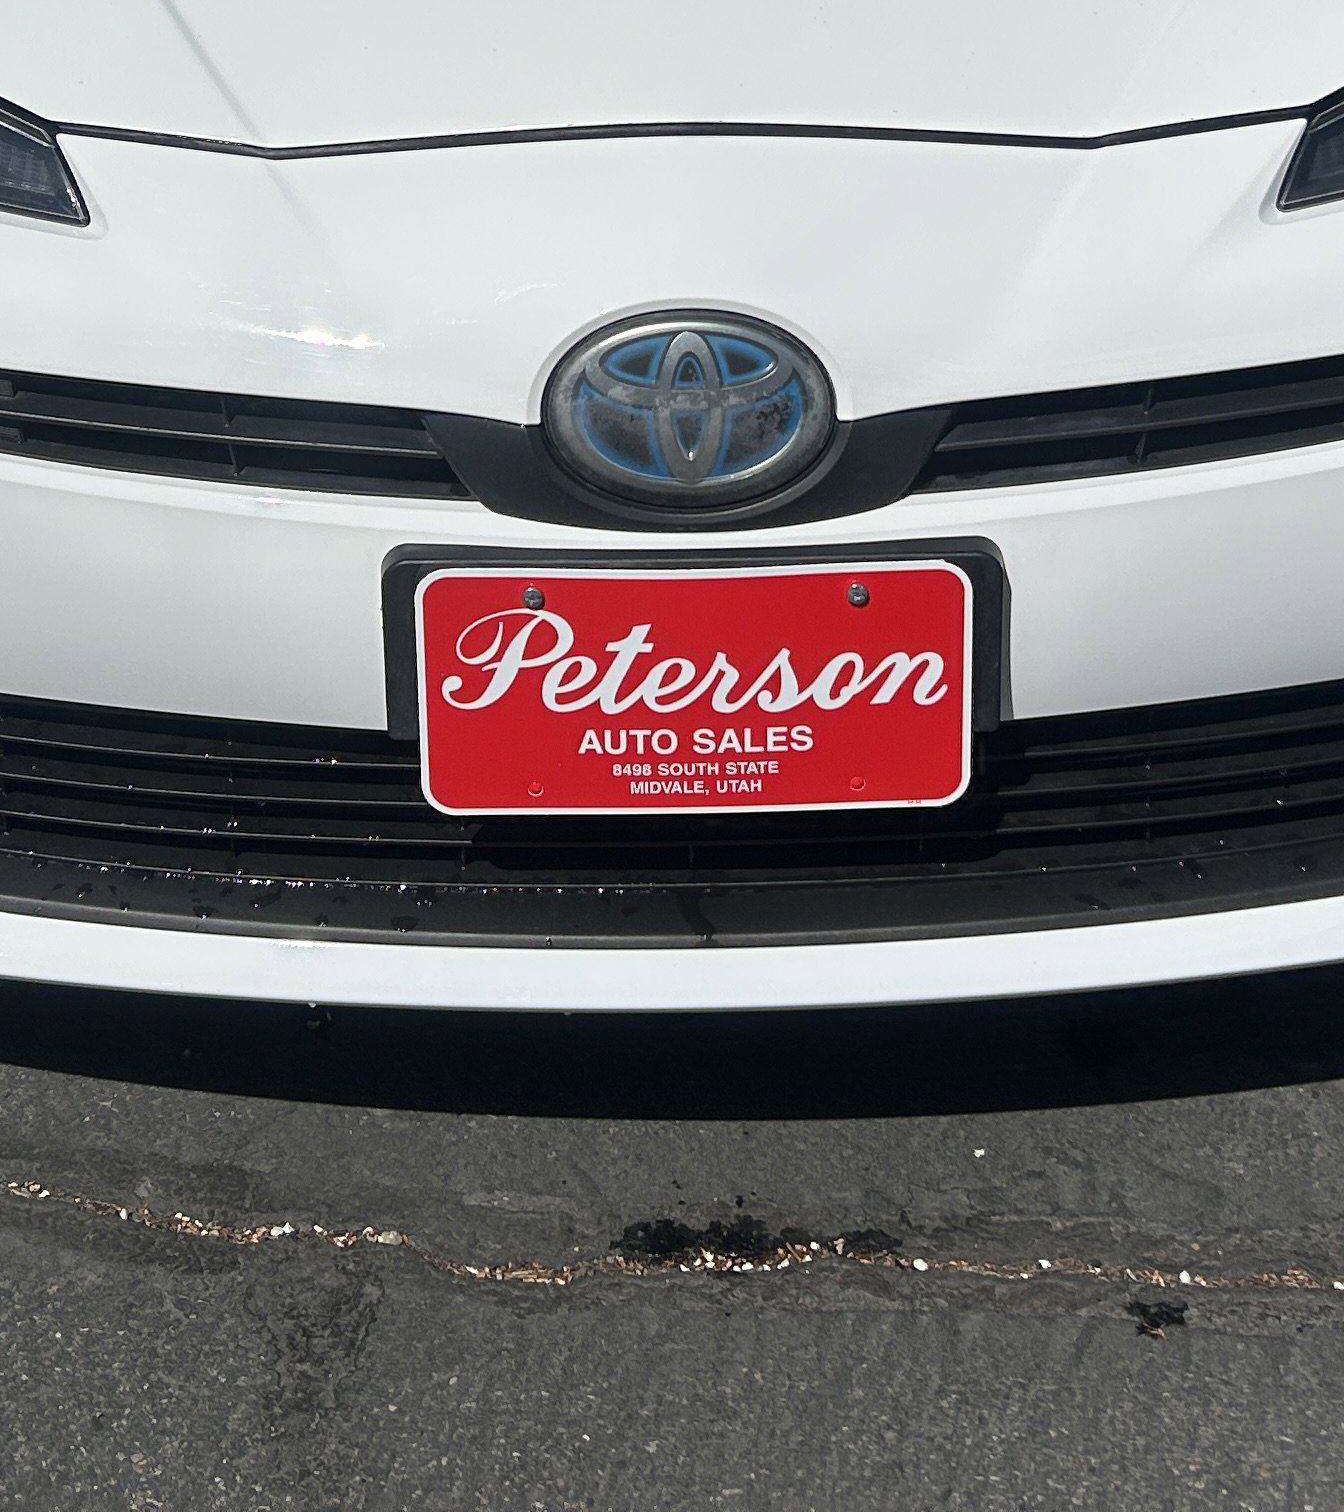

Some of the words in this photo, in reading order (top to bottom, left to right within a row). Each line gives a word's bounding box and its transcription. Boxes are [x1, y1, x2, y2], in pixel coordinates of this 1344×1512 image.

[442, 608, 948, 715] Peterson
[578, 728, 678, 755] AUTO
[692, 725, 814, 754] SALES
[612, 763, 653, 776] 8498
[657, 762, 719, 776] SOUTH
[725, 760, 780, 775] STATE
[630, 781, 710, 795] MIDVALE,
[716, 779, 763, 793] UTAH
